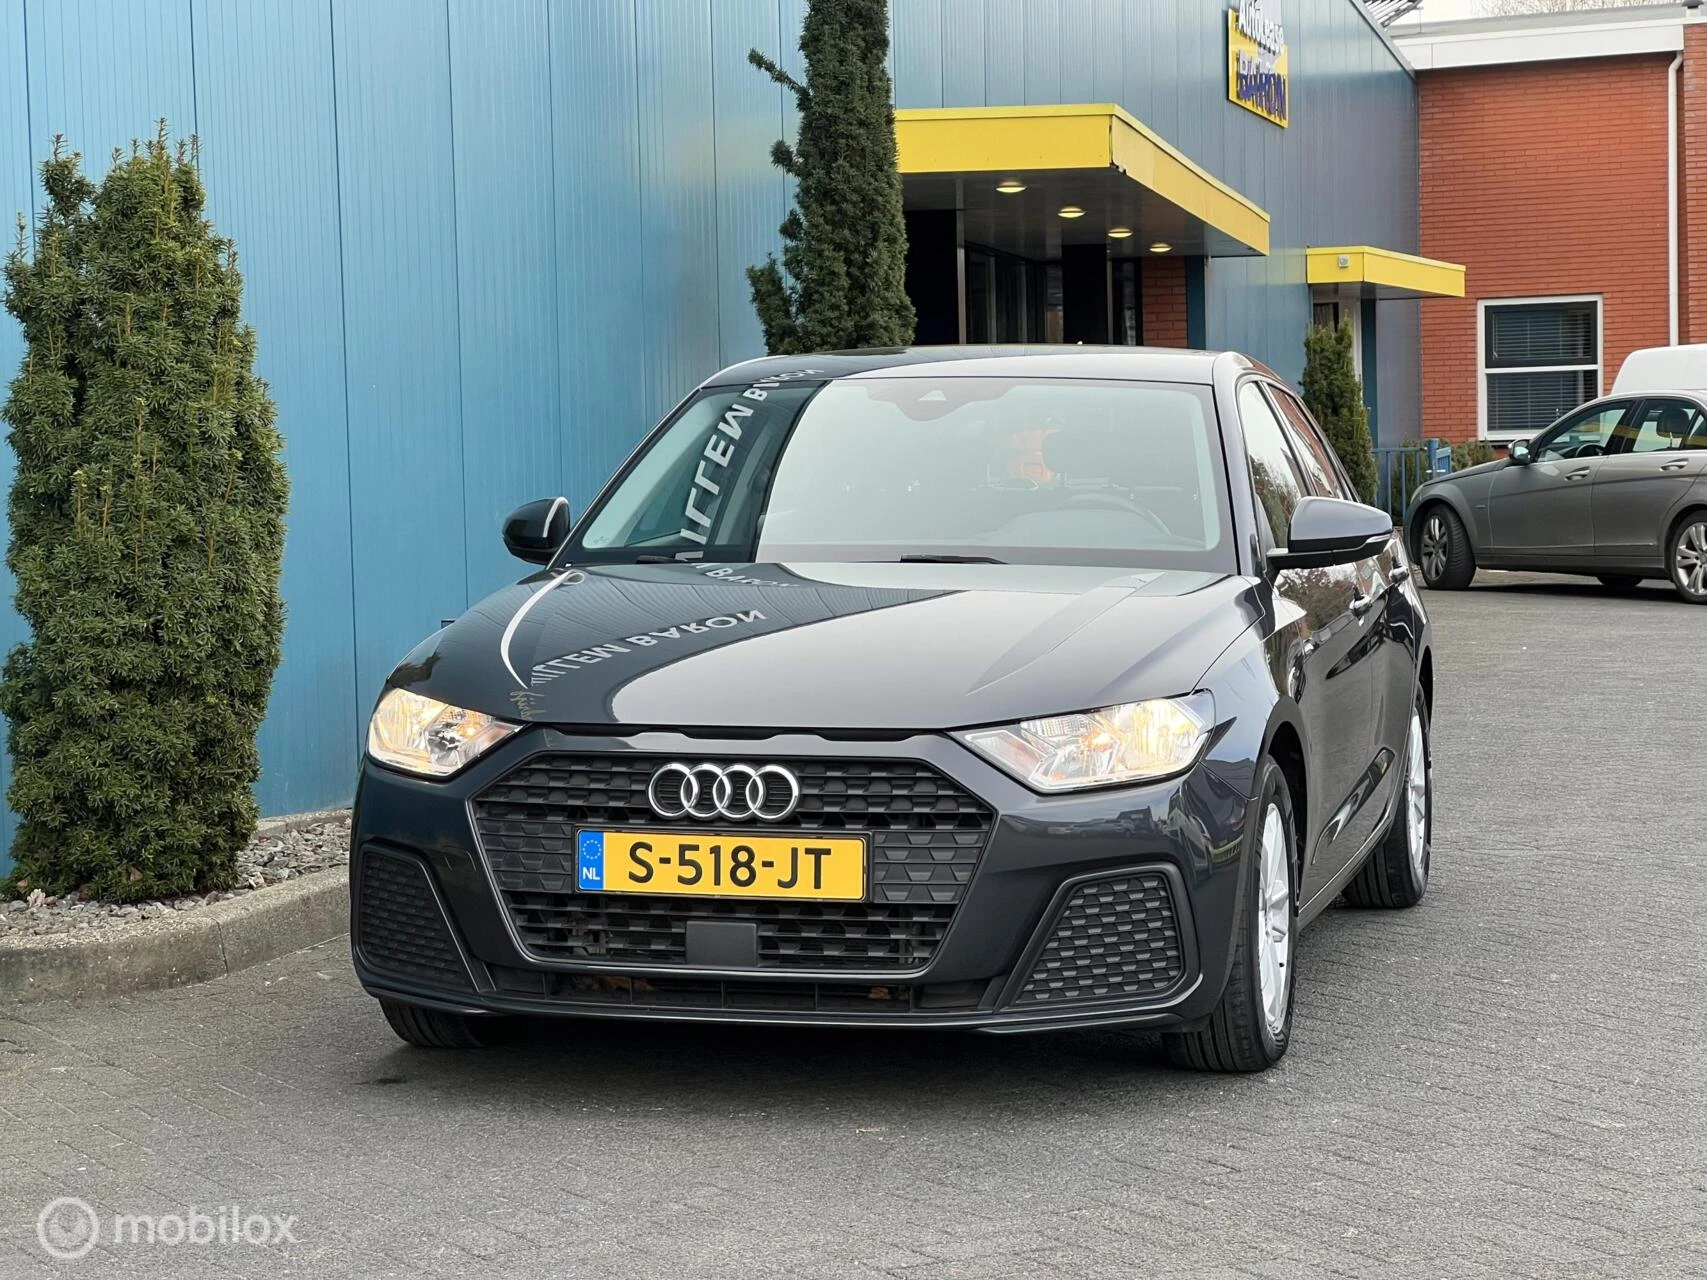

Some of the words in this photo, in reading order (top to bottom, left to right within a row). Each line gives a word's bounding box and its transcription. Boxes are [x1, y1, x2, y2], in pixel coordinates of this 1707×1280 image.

[1237, 50, 1287, 122] BARON
[582, 866, 601, 881] NL
[628, 841, 832, 890] S-518-JT
